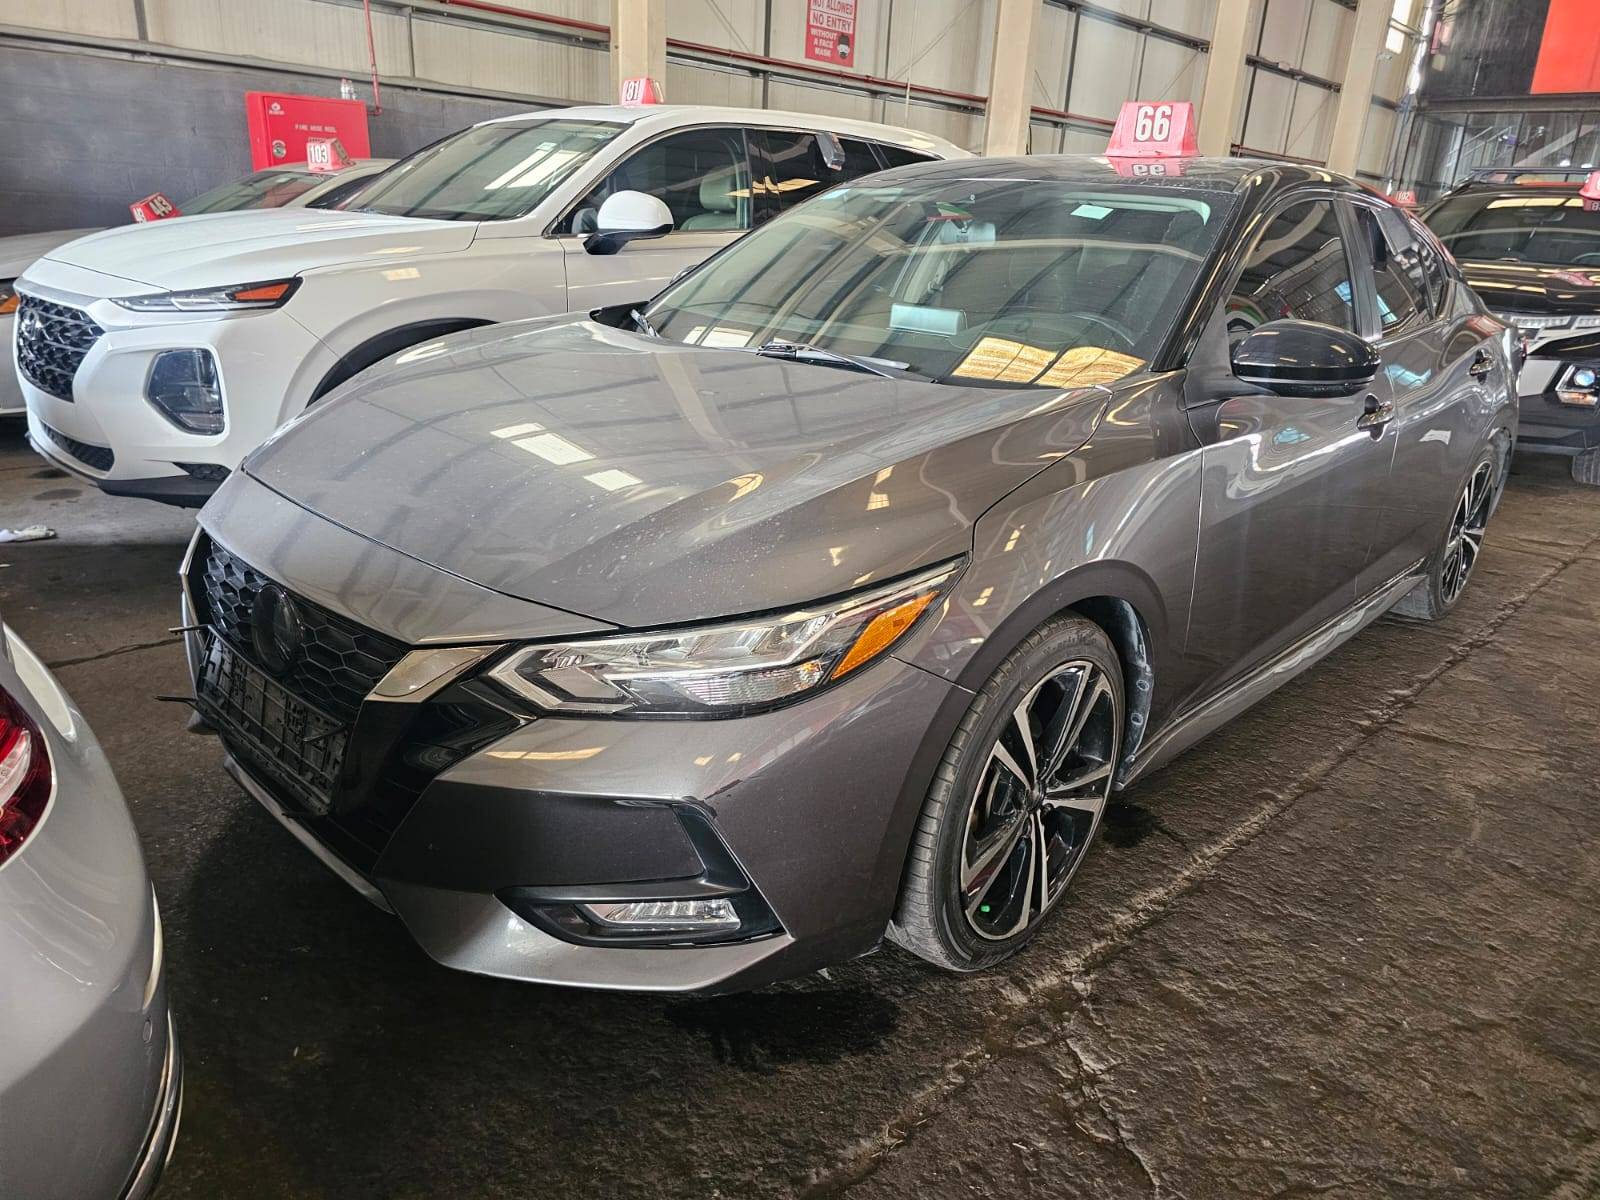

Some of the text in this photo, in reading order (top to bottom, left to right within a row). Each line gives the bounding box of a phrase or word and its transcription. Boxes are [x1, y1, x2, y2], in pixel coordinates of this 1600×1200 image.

[812, 12, 852, 32] NO ENTRY
[626, 80, 640, 101] 81
[1135, 105, 1172, 142] 66
[311, 145, 328, 163] 103
[149, 195, 173, 217] 443
